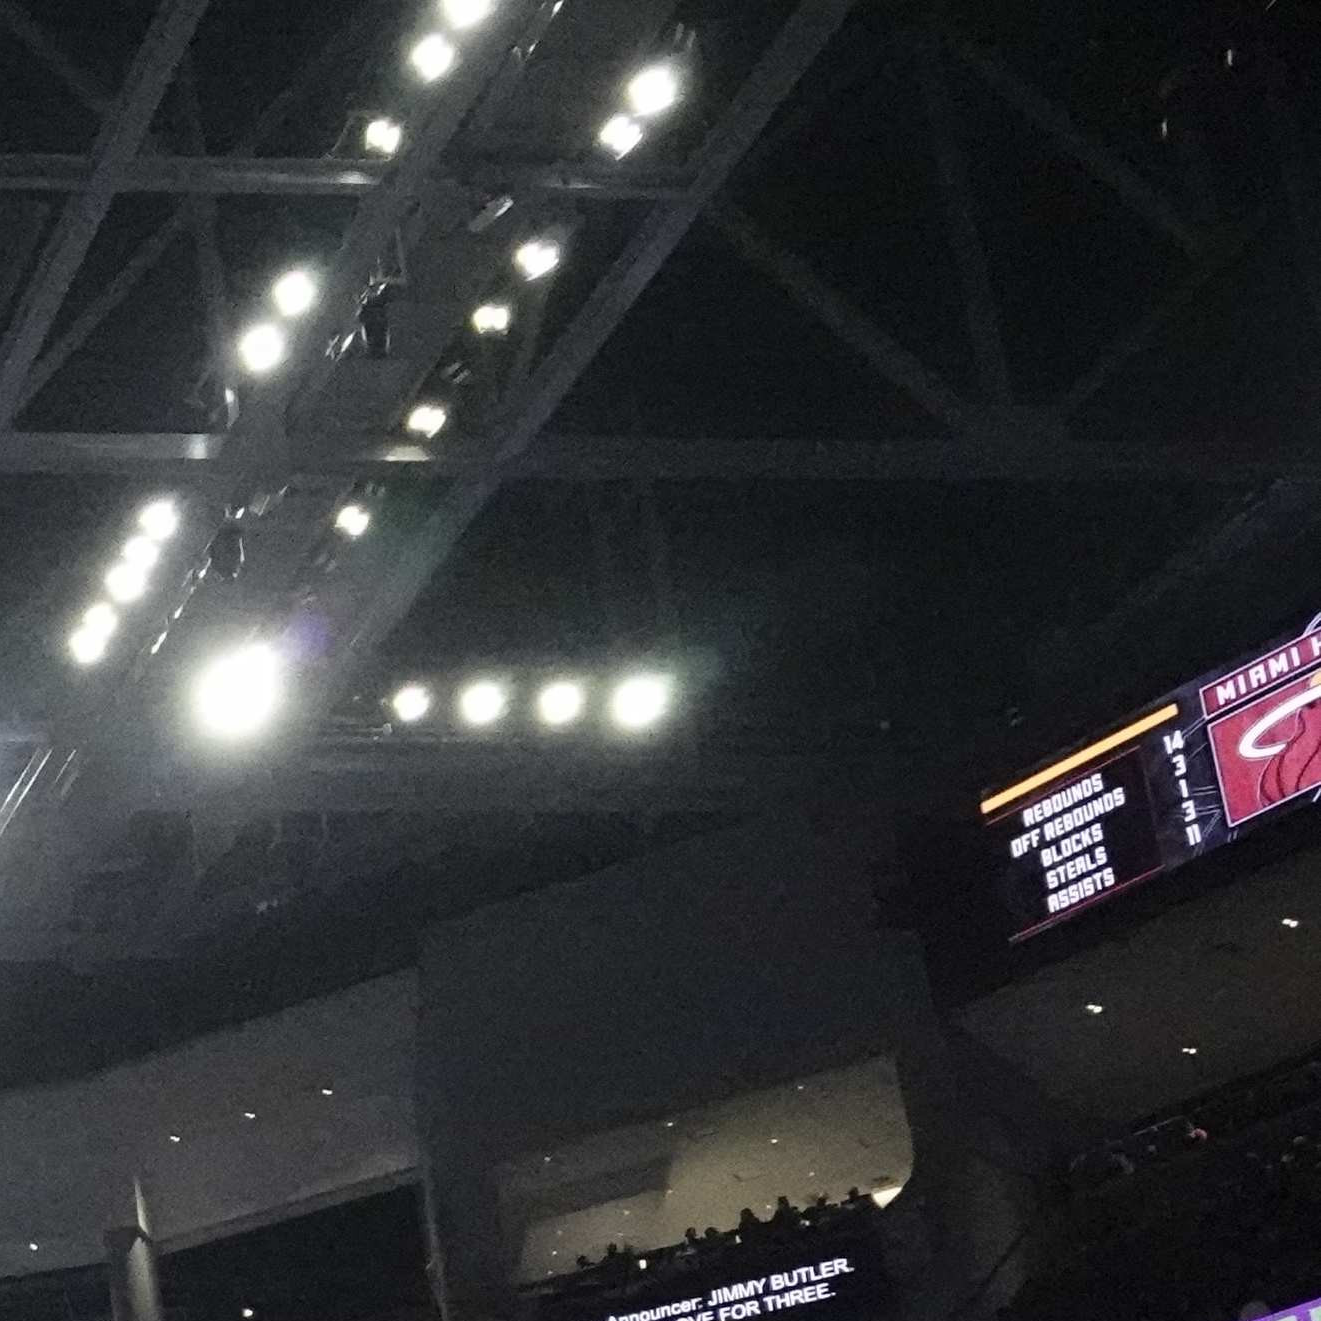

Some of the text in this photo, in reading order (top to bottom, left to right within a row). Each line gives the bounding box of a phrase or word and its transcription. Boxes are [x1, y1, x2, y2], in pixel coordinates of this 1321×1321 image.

[1216, 647, 1301, 705] MIAMI
[1010, 754, 1187, 858] OFF REBOUNDS 3
[1022, 730, 1184, 828] REBOUNDS 14
[1040, 779, 1189, 867] BLOCKS 1
[1045, 800, 1197, 890] STEALS 3
[1047, 824, 1201, 913] ASSISTS 11
[708, 1277, 767, 1307] JIMMY
[763, 1282, 836, 1314] THREE.
